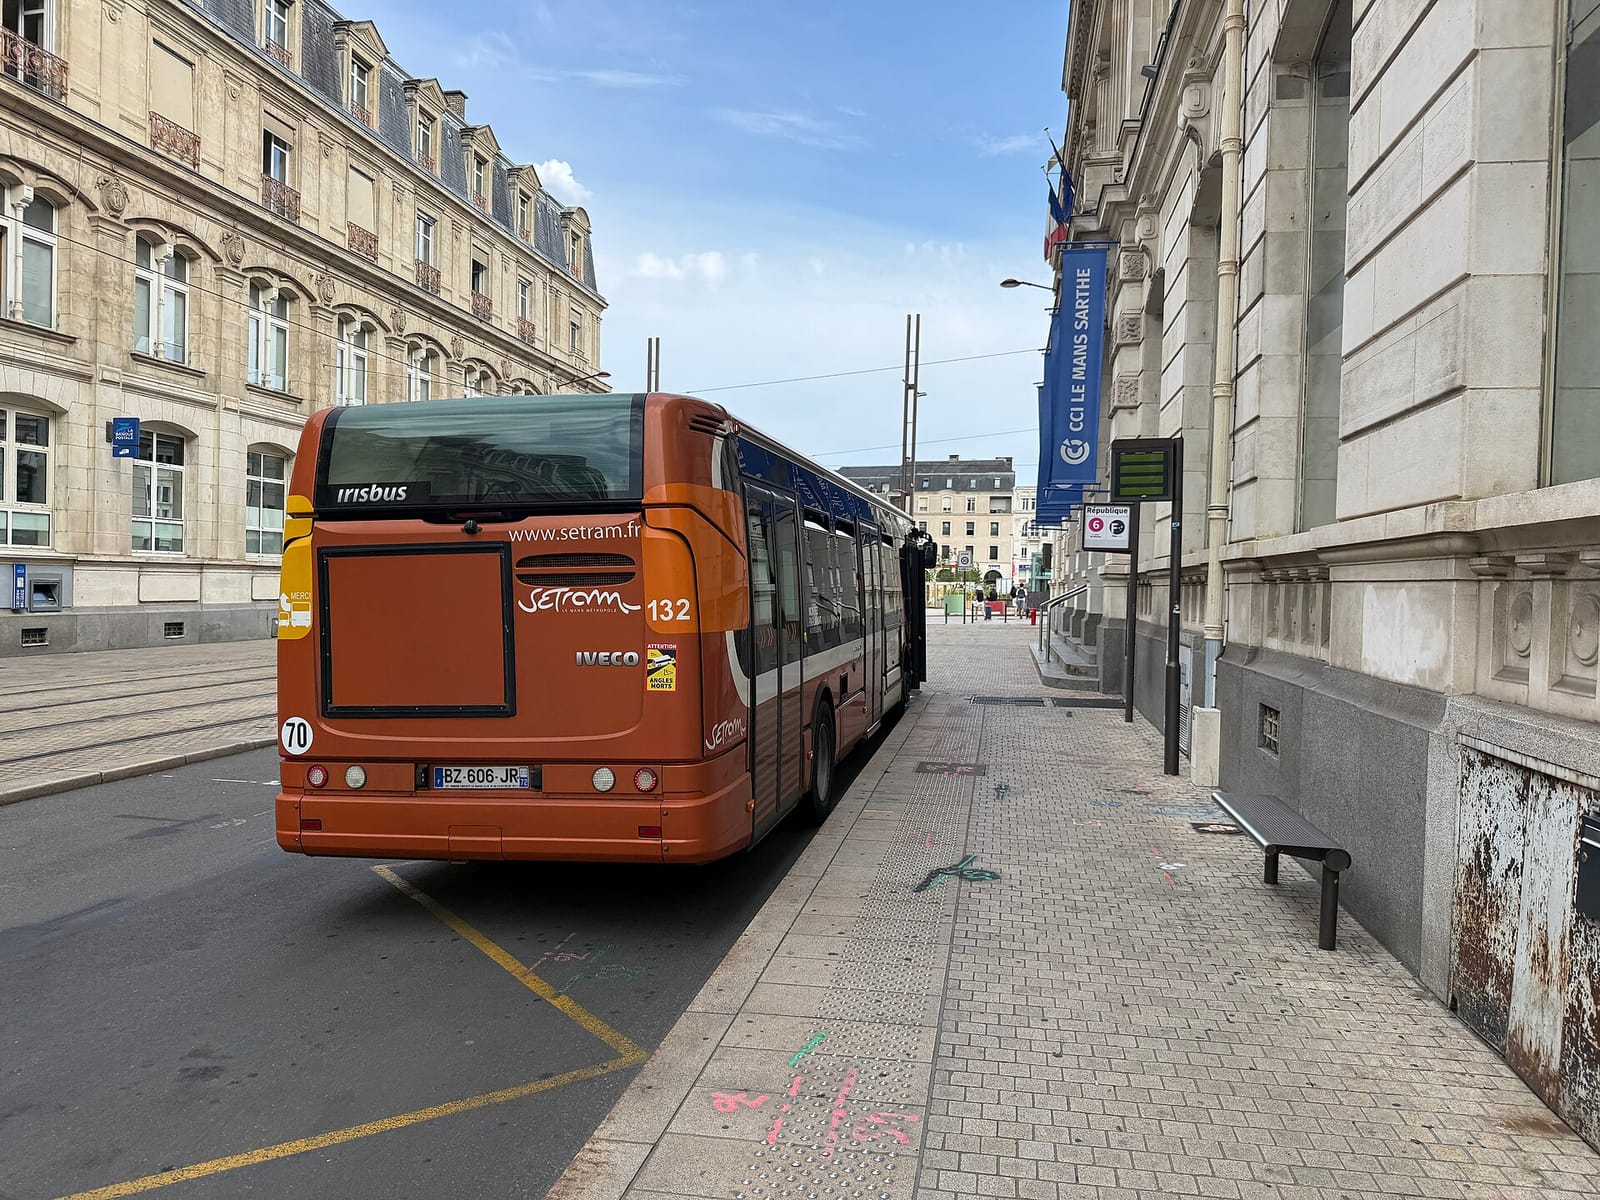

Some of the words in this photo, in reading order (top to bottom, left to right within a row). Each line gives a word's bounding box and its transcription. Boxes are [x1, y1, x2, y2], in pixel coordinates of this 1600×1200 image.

[1074, 268, 1091, 330] SARTHE
[1072, 334, 1088, 380] MANS
[1070, 384, 1086, 403] LE
[1069, 407, 1085, 432] CCI
[337, 484, 408, 503] irisbus
[1086, 506, 1128, 515] République
[508, 521, 641, 542] www.setram.fr
[1092, 520, 1100, 530] 6
[647, 599, 691, 621] 132
[576, 651, 639, 666] IVECO
[285, 722, 307, 748] 70
